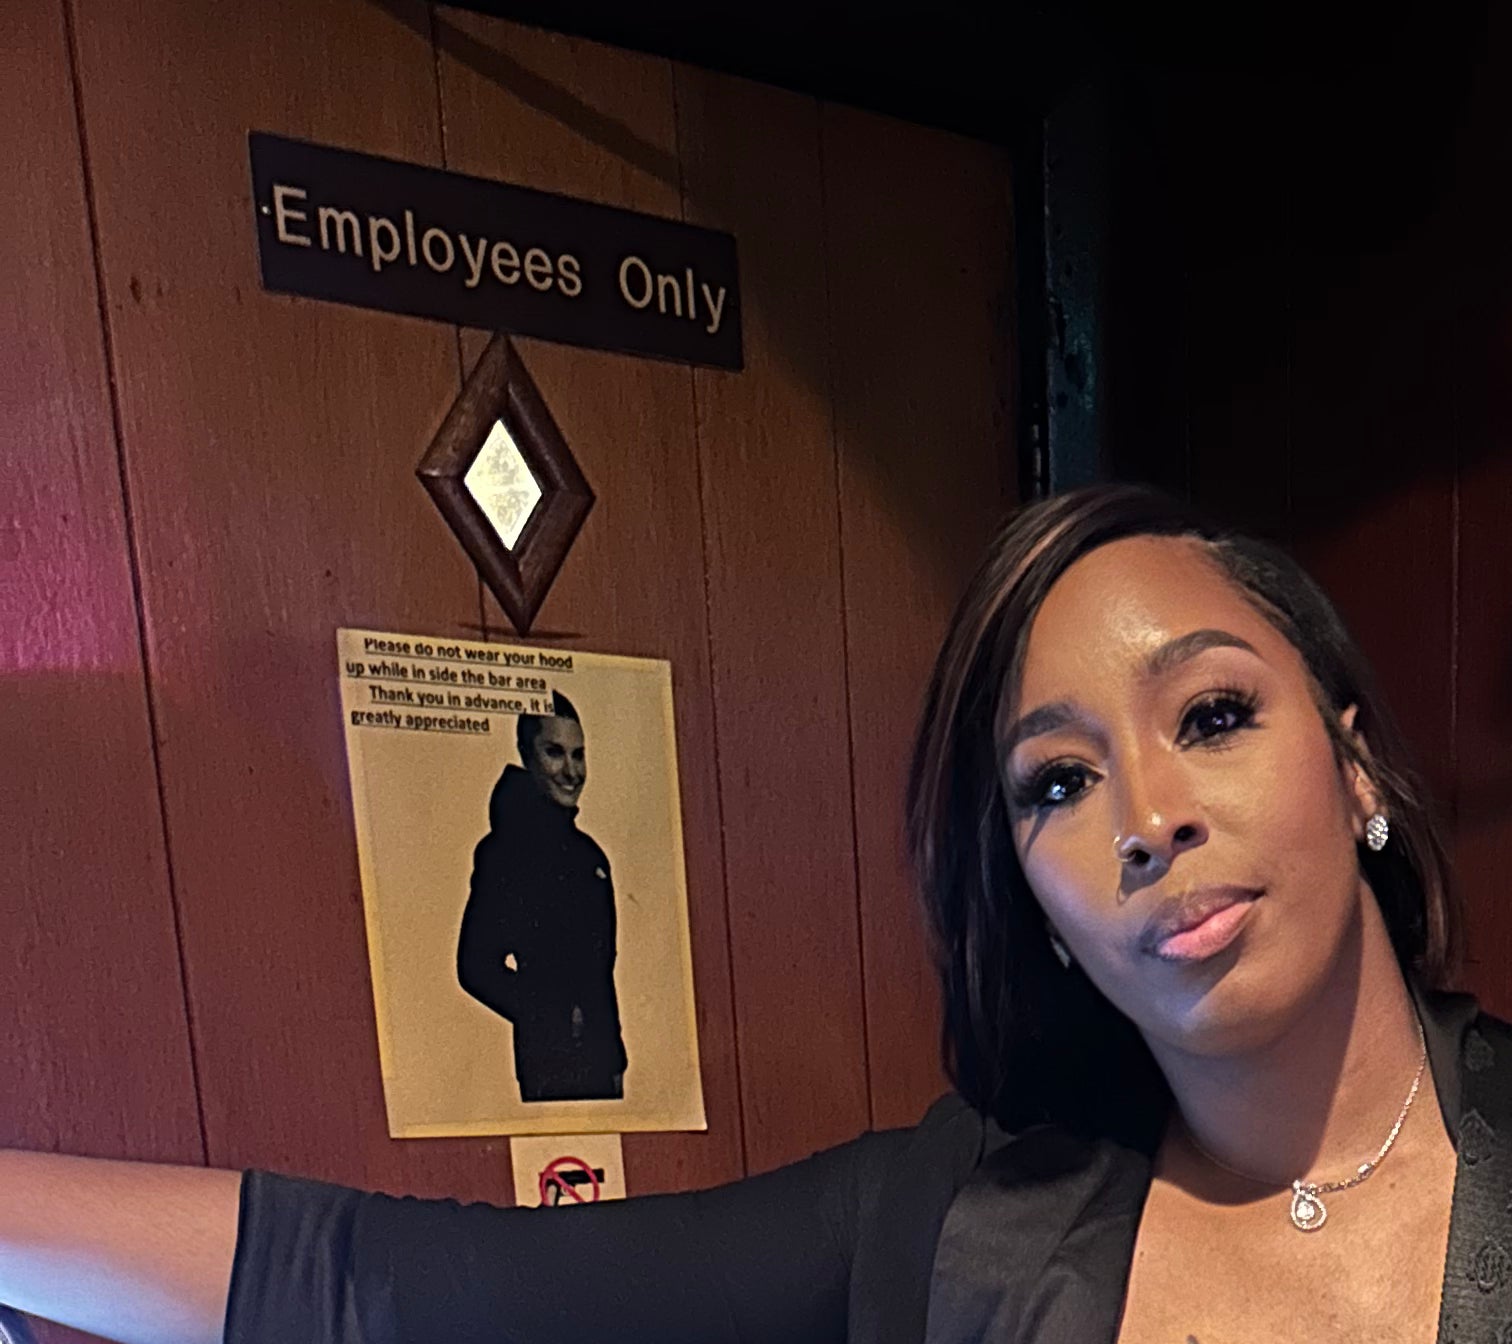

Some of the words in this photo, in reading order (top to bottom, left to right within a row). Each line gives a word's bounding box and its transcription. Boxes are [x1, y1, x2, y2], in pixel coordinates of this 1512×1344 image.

[273, 184, 583, 297] Employees
[618, 256, 726, 333] Only
[364, 638, 410, 653] Please
[415, 642, 433, 656] do
[437, 646, 461, 659] not
[465, 648, 500, 662] wear
[503, 651, 535, 666] your
[538, 652, 573, 668] hood
[345, 661, 365, 678] up
[369, 660, 408, 678] while
[412, 663, 426, 678] in
[429, 666, 458, 681] side
[461, 668, 485, 685] the
[488, 670, 512, 687] bar
[516, 675, 547, 690] area
[369, 684, 414, 702] Thank
[417, 692, 444, 707] you
[447, 690, 461, 706] in
[464, 694, 527, 714] advance,
[530, 698, 540, 713] it
[544, 699, 554, 713] is
[351, 710, 401, 728] greatly
[405, 713, 489, 731] appreciated
